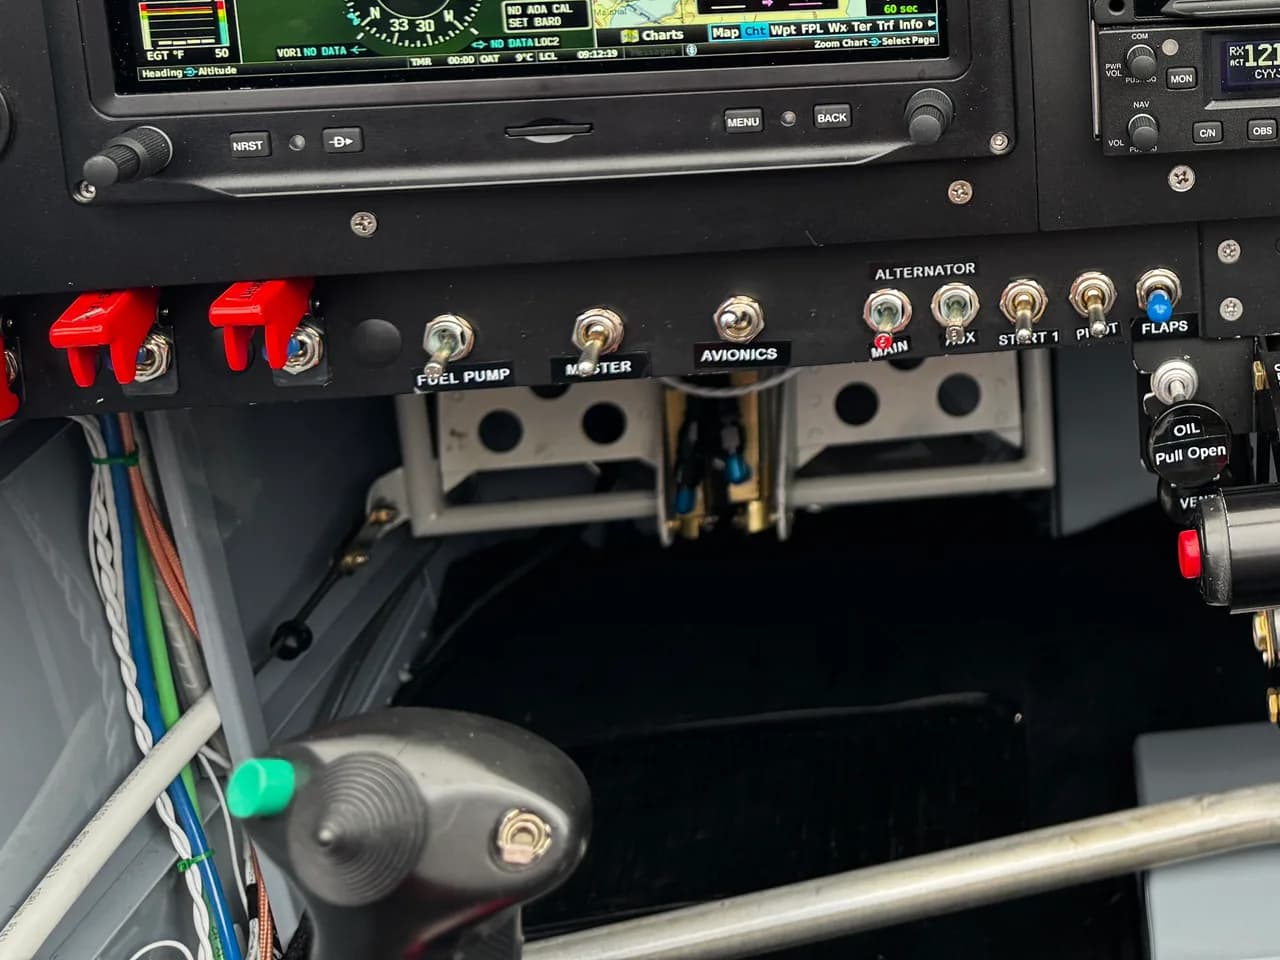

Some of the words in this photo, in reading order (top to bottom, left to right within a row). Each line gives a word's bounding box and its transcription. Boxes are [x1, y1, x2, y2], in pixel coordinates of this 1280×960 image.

[642, 28, 684, 41] Charts
[712, 27, 739, 40] Map
[771, 24, 796, 37] Wpt
[801, 23, 823, 34] FPL
[899, 18, 923, 30] Info
[1171, 74, 1193, 85] MON
[727, 116, 760, 128] MENU
[817, 111, 847, 124] BACK
[1199, 128, 1216, 139] C/N
[1253, 126, 1273, 136] OBS
[233, 140, 263, 151] NRST
[875, 262, 976, 280] ALTERNATOR
[1141, 320, 1188, 335] FLAPS
[701, 348, 778, 362] AVIONICS
[464, 368, 510, 383] PUMP
[1173, 423, 1200, 436] OIL
[1155, 446, 1184, 466] Pull
[1187, 443, 1226, 461] Open
